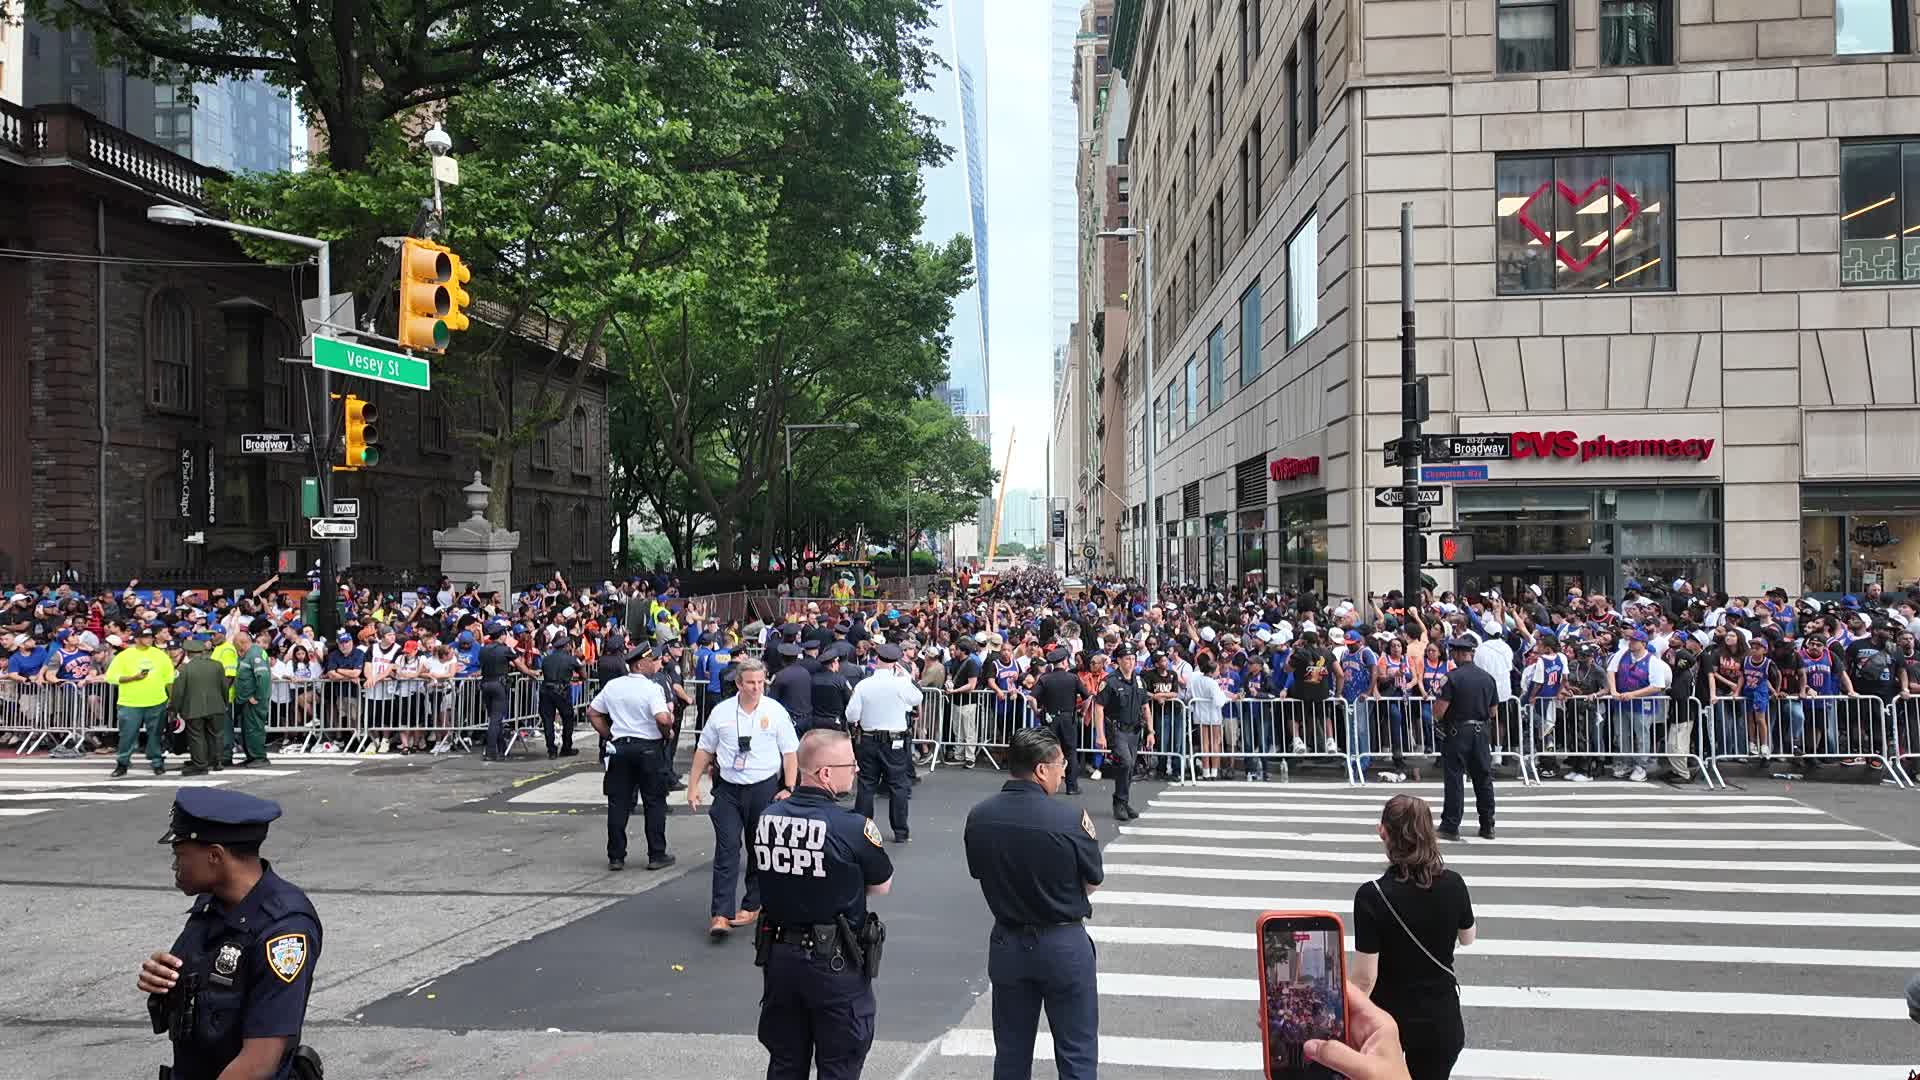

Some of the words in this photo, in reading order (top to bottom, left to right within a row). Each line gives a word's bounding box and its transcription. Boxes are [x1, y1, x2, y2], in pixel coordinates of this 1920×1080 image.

[346, 350, 383, 377] Vesey
[388, 359, 400, 377] St
[245, 439, 289, 451] Broadway
[1454, 441, 1505, 455] Broadway
[1511, 431, 1578, 459] CVS
[1580, 434, 1715, 462] pharmacy
[180, 486, 191, 517] Chapel
[1383, 492, 1404, 501] ONE
[336, 504, 353, 513] WAY
[338, 524, 353, 533] WAY
[755, 814, 826, 850] NYPD
[754, 845, 826, 877] DCPI
